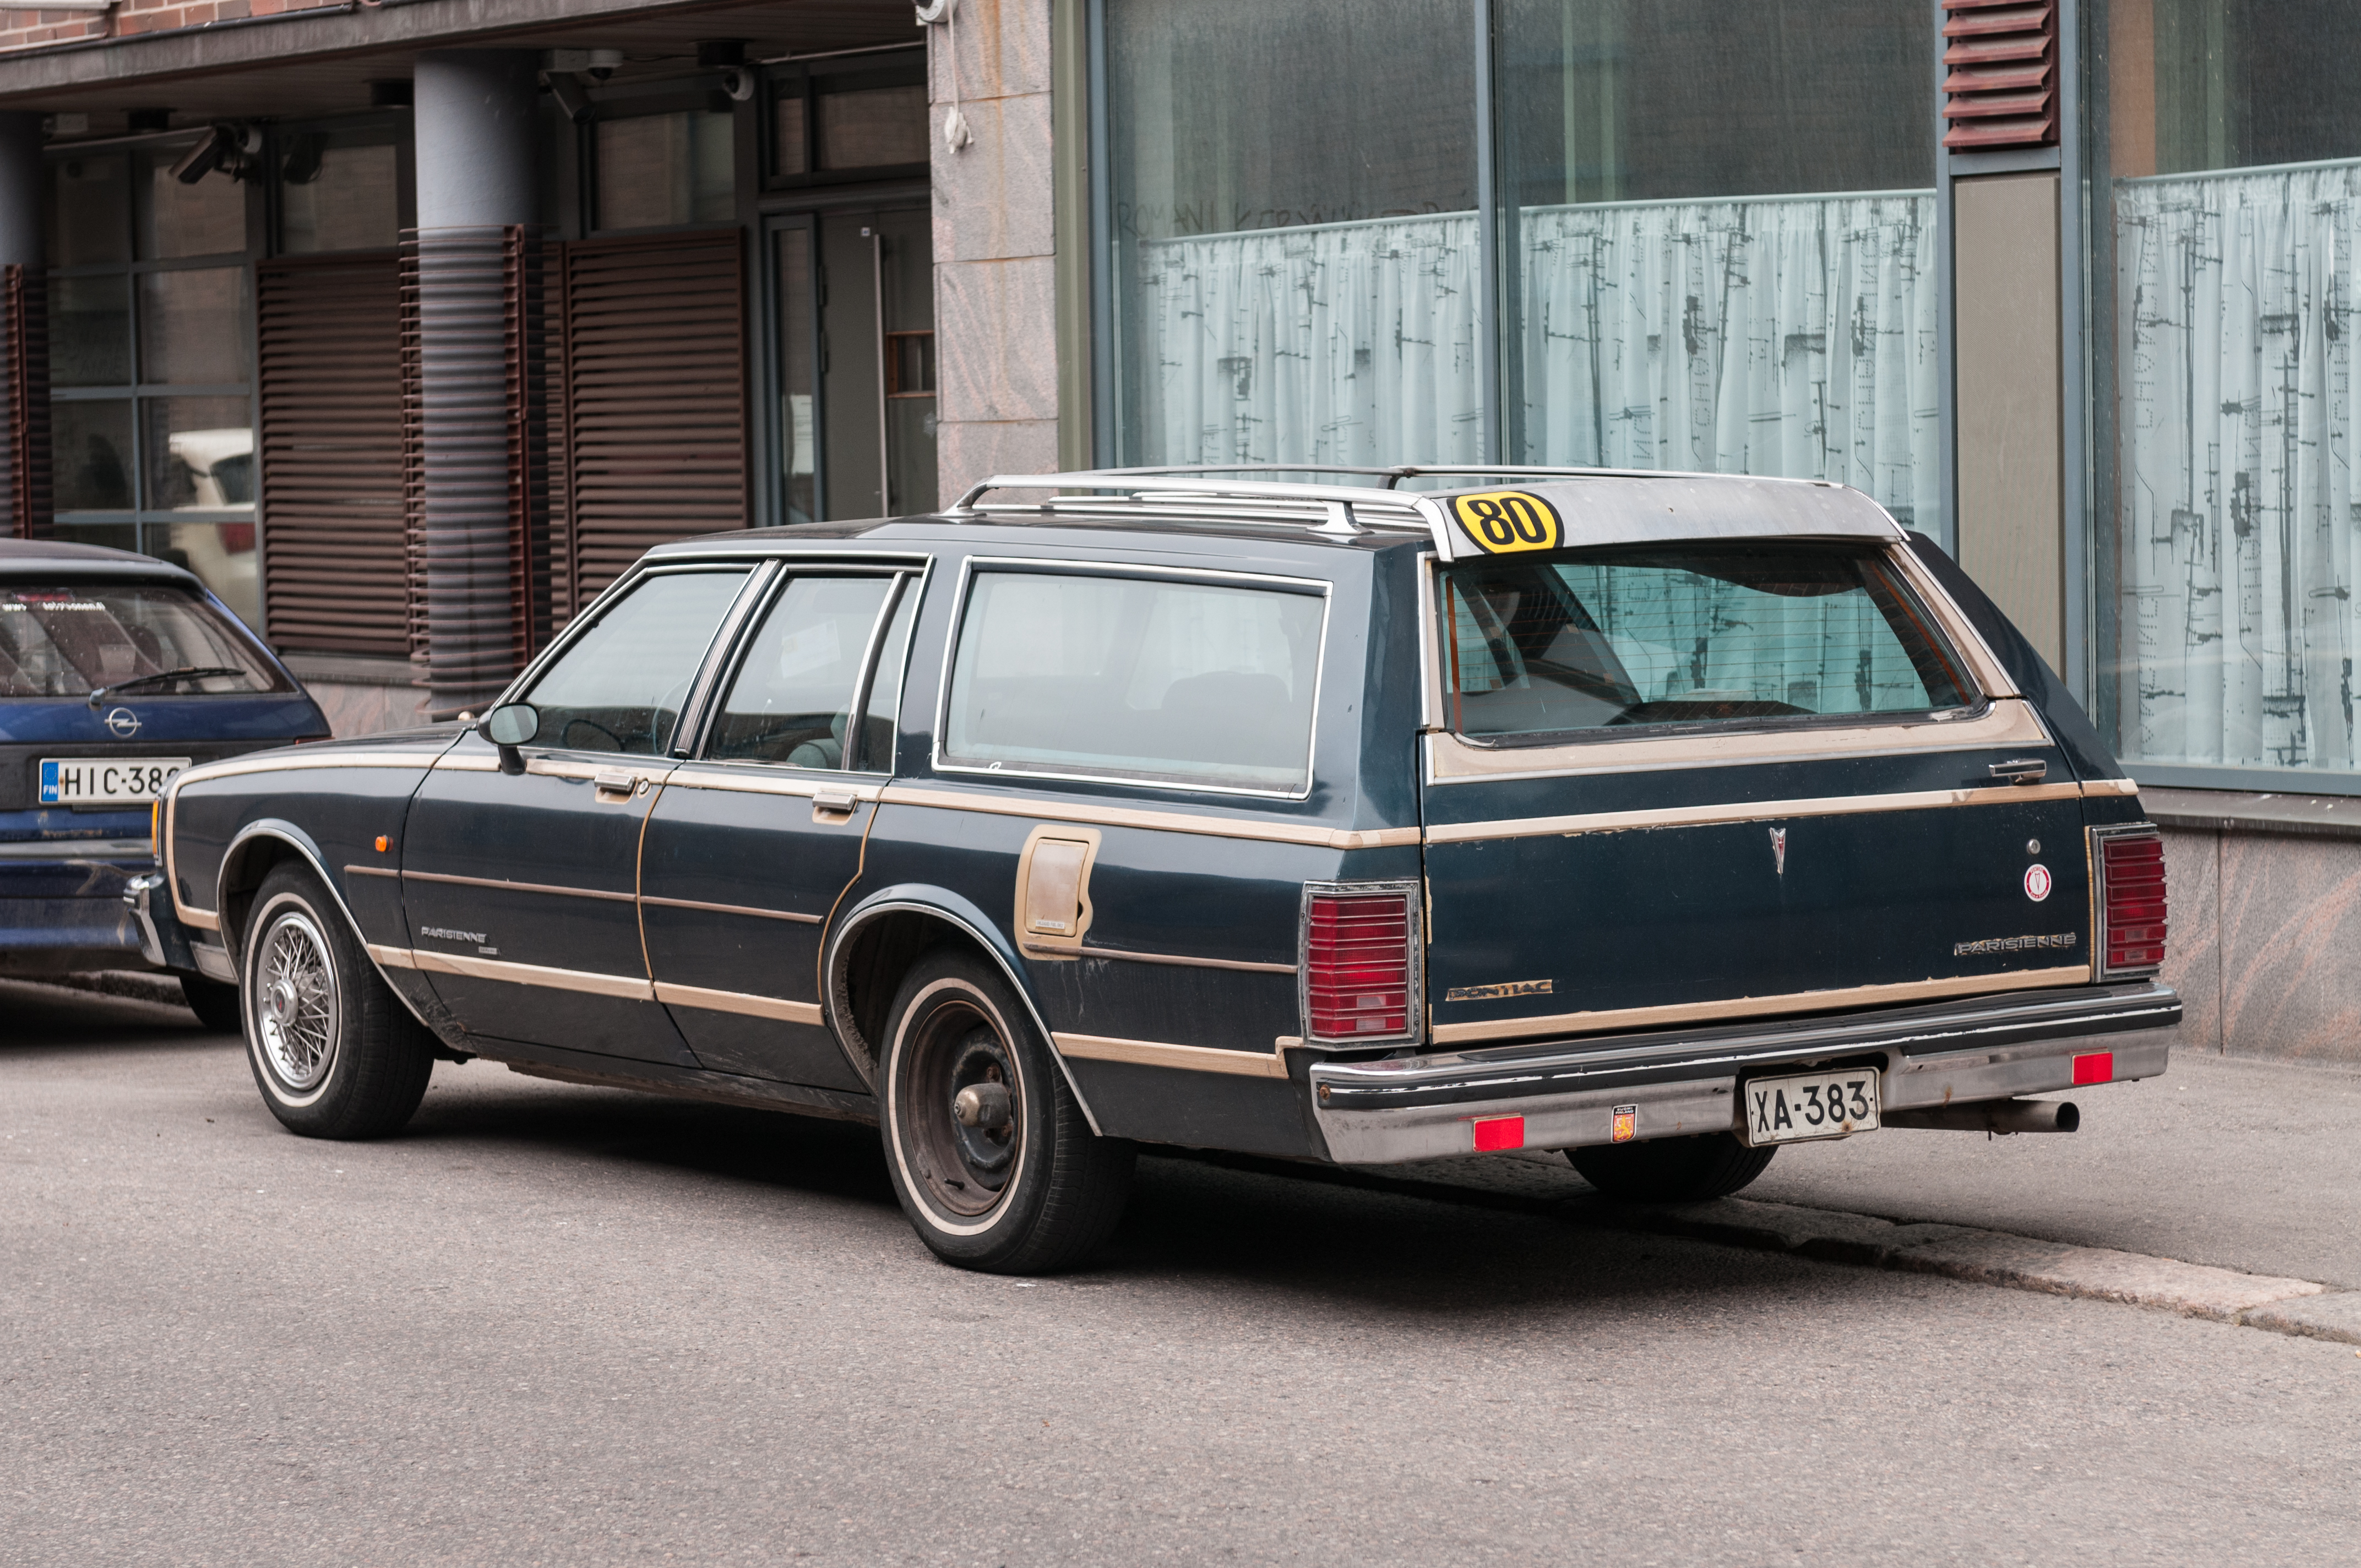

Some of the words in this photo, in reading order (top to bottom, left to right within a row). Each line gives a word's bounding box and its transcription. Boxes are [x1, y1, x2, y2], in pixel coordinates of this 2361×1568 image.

[1467, 497, 1547, 545] 80
[43, 785, 57, 795] FIN
[421, 926, 487, 944] PARISIENNE
[1955, 933, 2076, 954] PARISIENNE
[1449, 981, 1552, 1000] PONTIAC
[1754, 1080, 1869, 1133] XA-383
